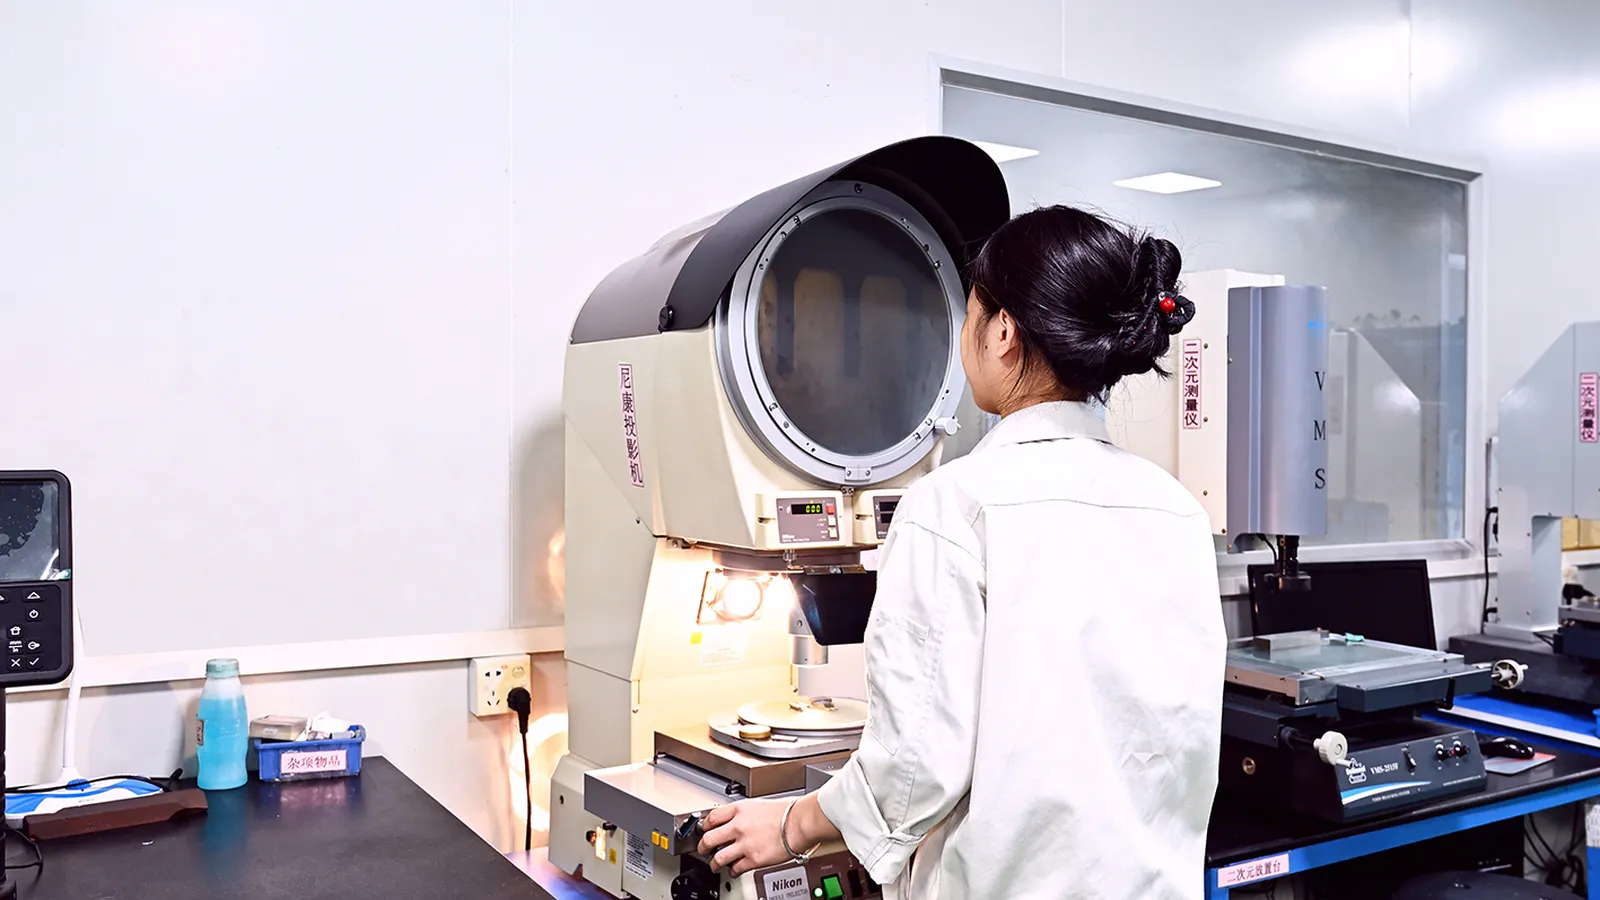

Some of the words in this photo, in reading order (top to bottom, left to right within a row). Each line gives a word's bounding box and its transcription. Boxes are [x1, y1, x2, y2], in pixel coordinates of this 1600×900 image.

[1184, 343, 1199, 426] 二次元测量仪
[620, 367, 643, 483] 尼康投影机
[1313, 371, 1326, 489] VMS
[287, 755, 341, 769] 杂项物品
[772, 877, 802, 891] Nikon
[1227, 860, 1281, 882] 二次元放置台
